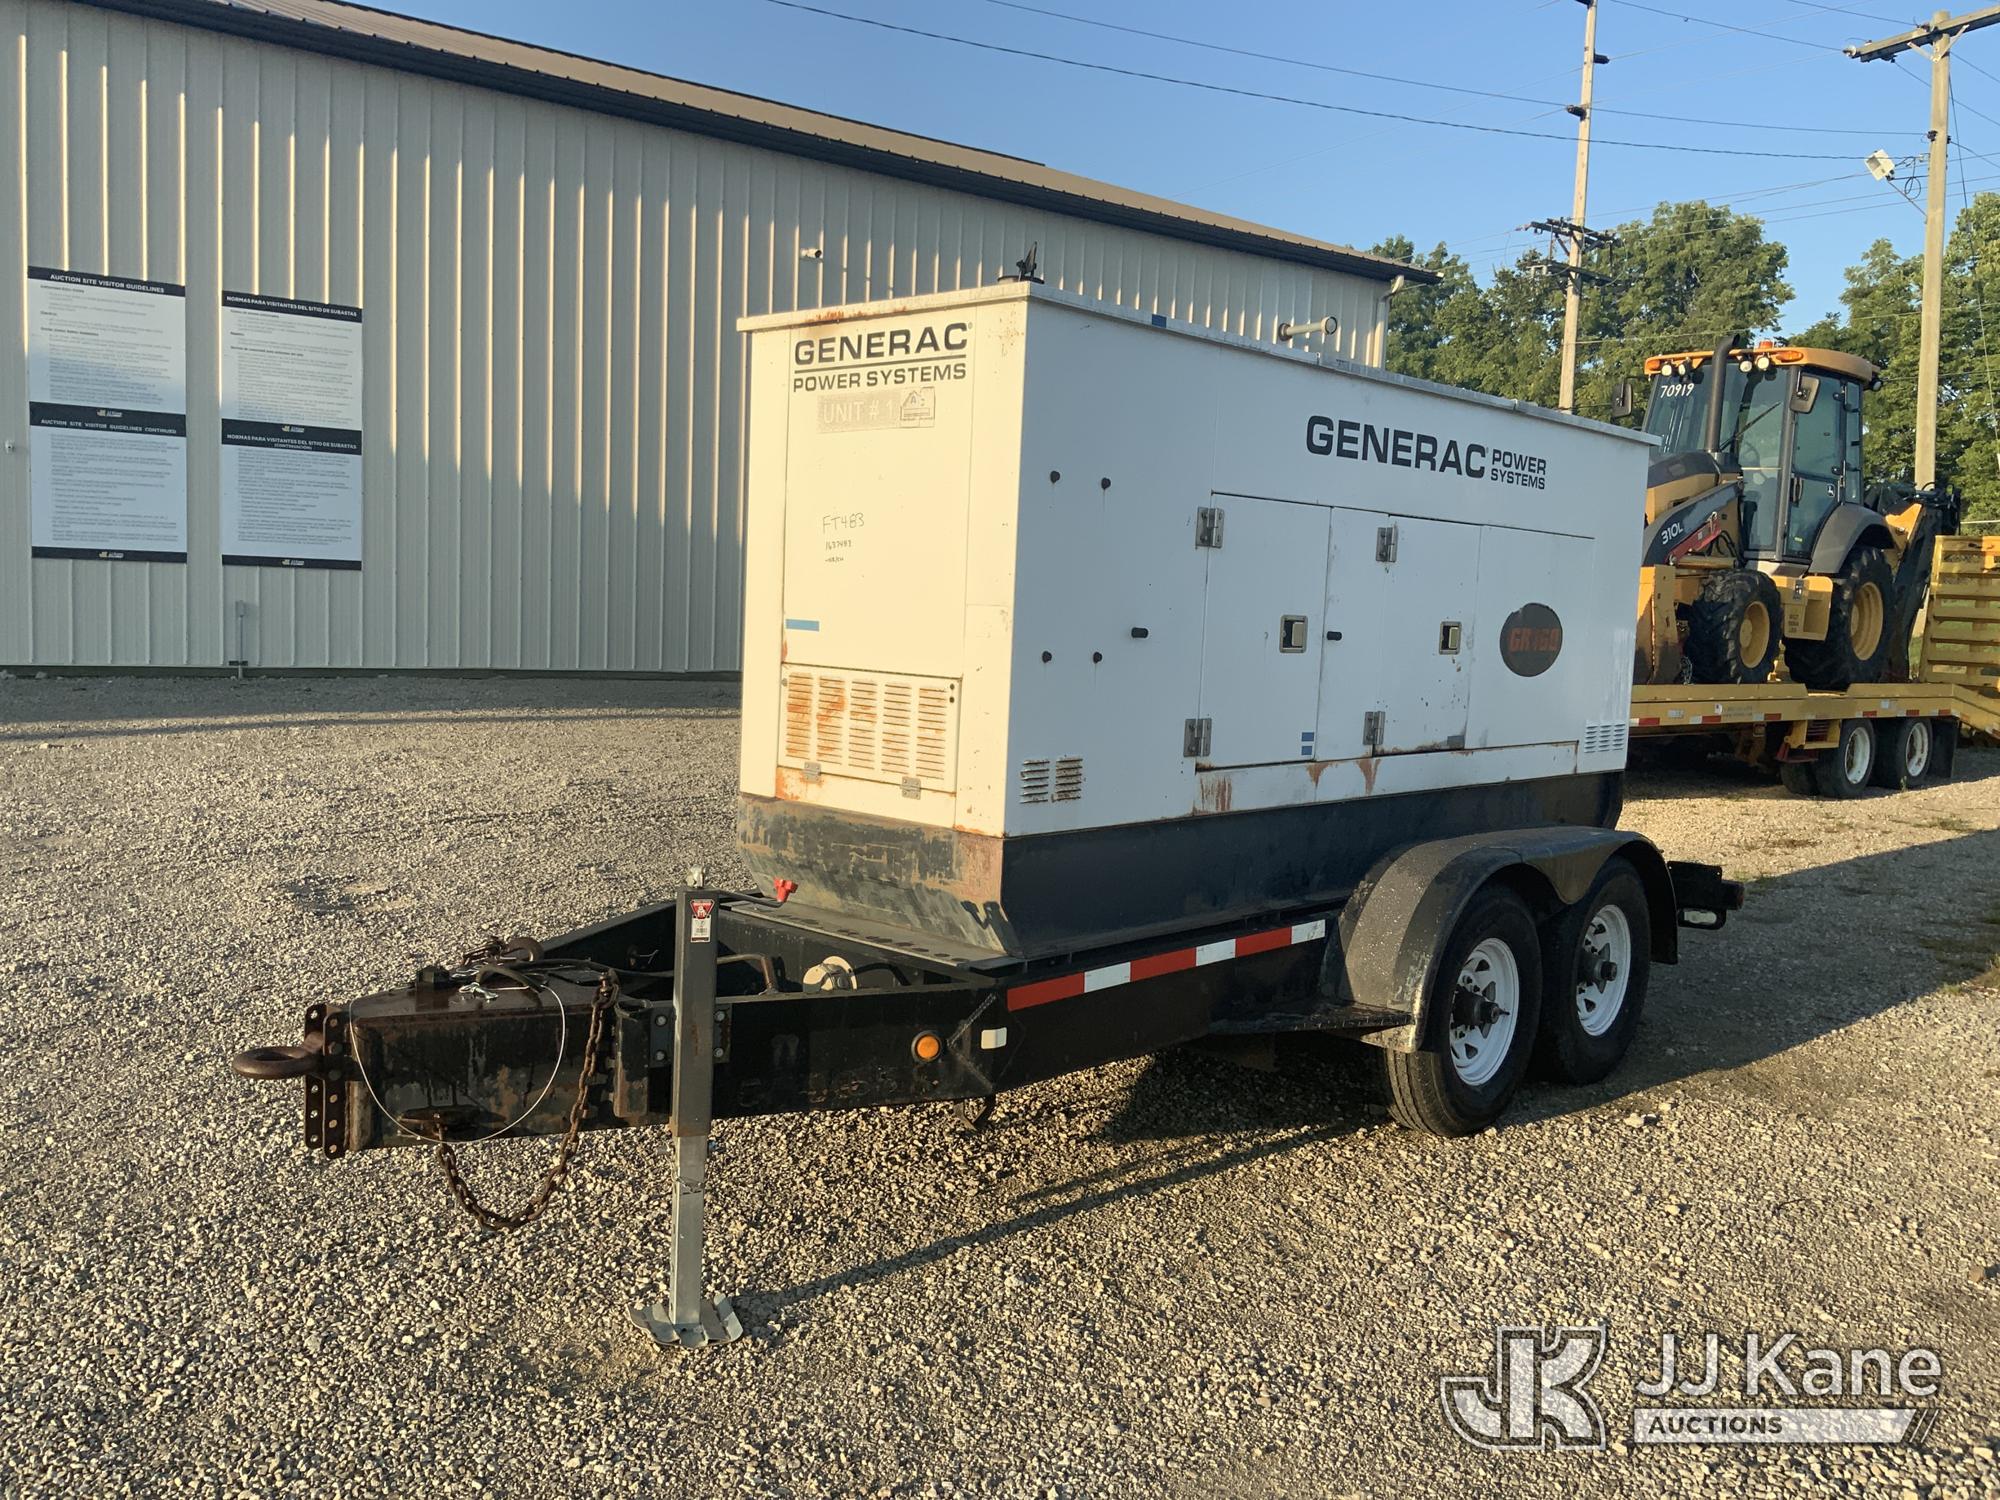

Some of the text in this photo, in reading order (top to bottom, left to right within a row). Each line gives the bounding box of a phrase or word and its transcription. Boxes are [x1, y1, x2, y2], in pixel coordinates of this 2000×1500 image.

[50, 274, 81, 283] AUCTION
[98, 280, 125, 289] VISITOR
[126, 283, 165, 294] GUIDELINES
[226, 296, 251, 304] NORMAS
[266, 301, 298, 310] VISITANTES
[330, 308, 357, 317] SUBASTAS
[794, 322, 968, 366] GENERAC
[793, 362, 967, 393] POWER SYSTEMS
[1660, 382, 1695, 399] 70919
[822, 401, 865, 424] UNIT
[109, 424, 143, 432] GUIDELINES
[266, 437, 297, 445] VISITANTES
[1306, 415, 1487, 479] GENERAC
[1491, 449, 1547, 476] POWER
[1490, 468, 1546, 491] SYSTEMS
[1661, 522, 1684, 545] 310L
